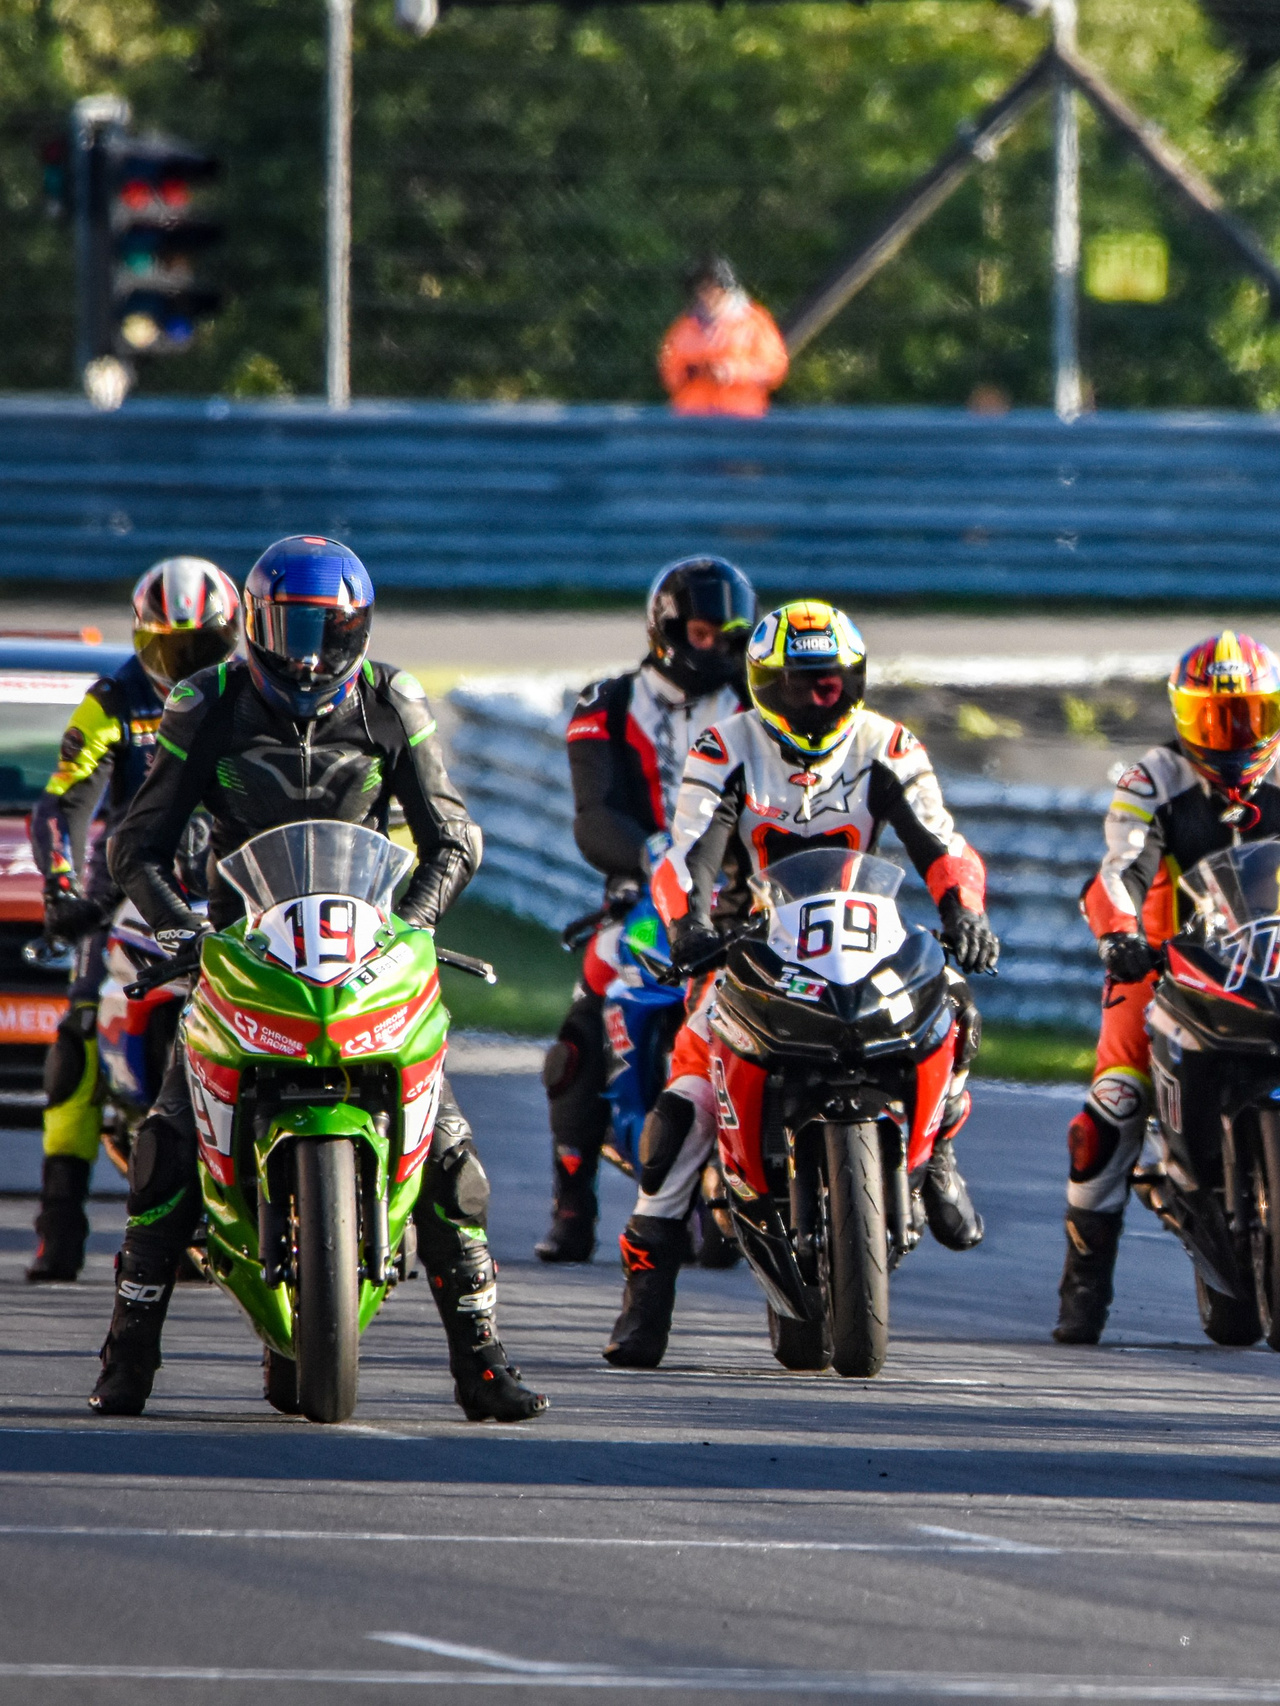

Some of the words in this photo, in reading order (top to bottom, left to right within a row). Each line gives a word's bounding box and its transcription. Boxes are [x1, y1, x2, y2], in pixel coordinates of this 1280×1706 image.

[795, 638, 830, 651] SHOEI
[284, 899, 356, 970] 19
[797, 899, 877, 961] 69
[0, 1003, 62, 1032] MED
[234, 1011, 258, 1041] CR
[261, 1026, 303, 1051] CHROME
[344, 1031, 375, 1054] CR
[373, 1006, 408, 1034] CHROME
[260, 1035, 295, 1055] RACING
